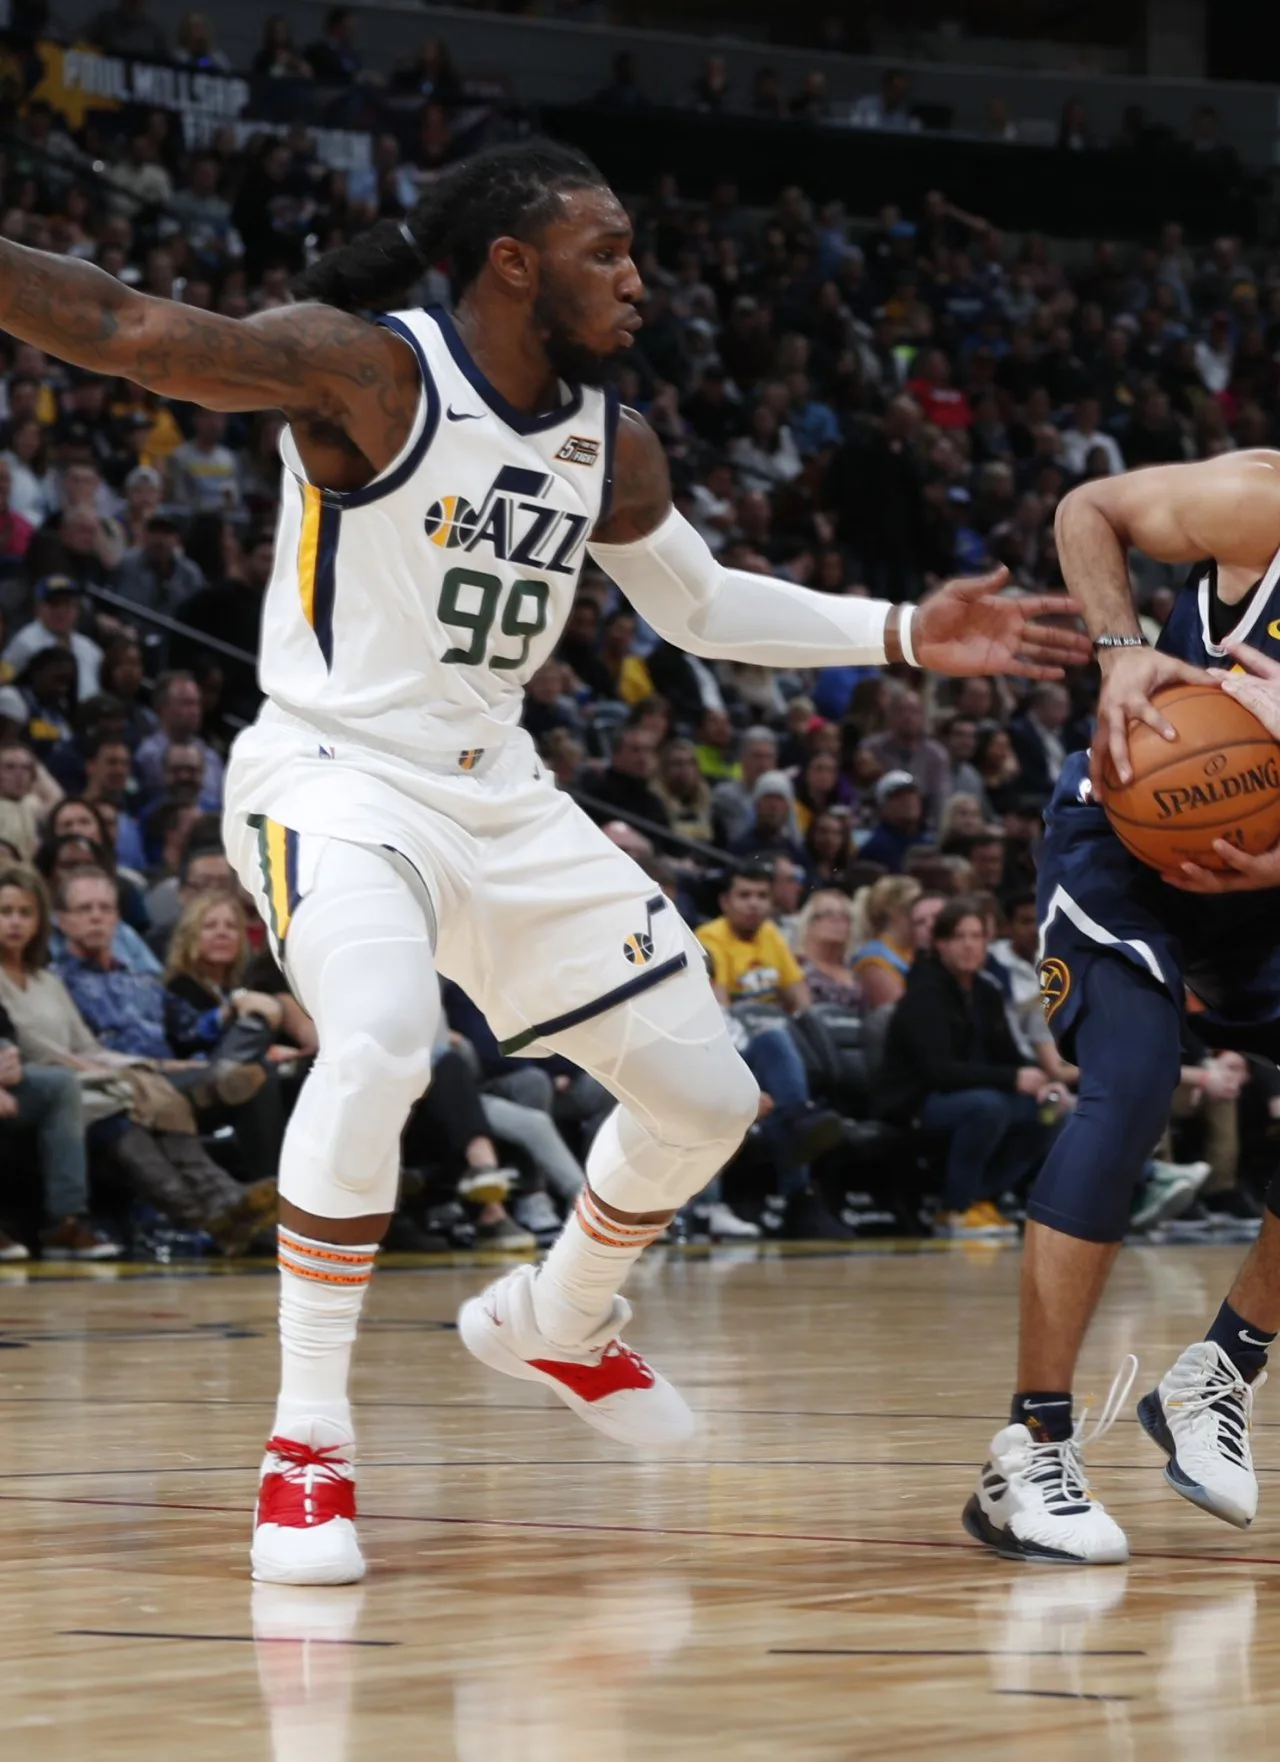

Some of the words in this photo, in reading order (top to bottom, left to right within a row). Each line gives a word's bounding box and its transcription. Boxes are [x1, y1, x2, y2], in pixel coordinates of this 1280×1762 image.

[425, 464, 590, 576] JAZZ
[437, 566, 550, 671] 99
[1153, 758, 1279, 820] SPALDING
